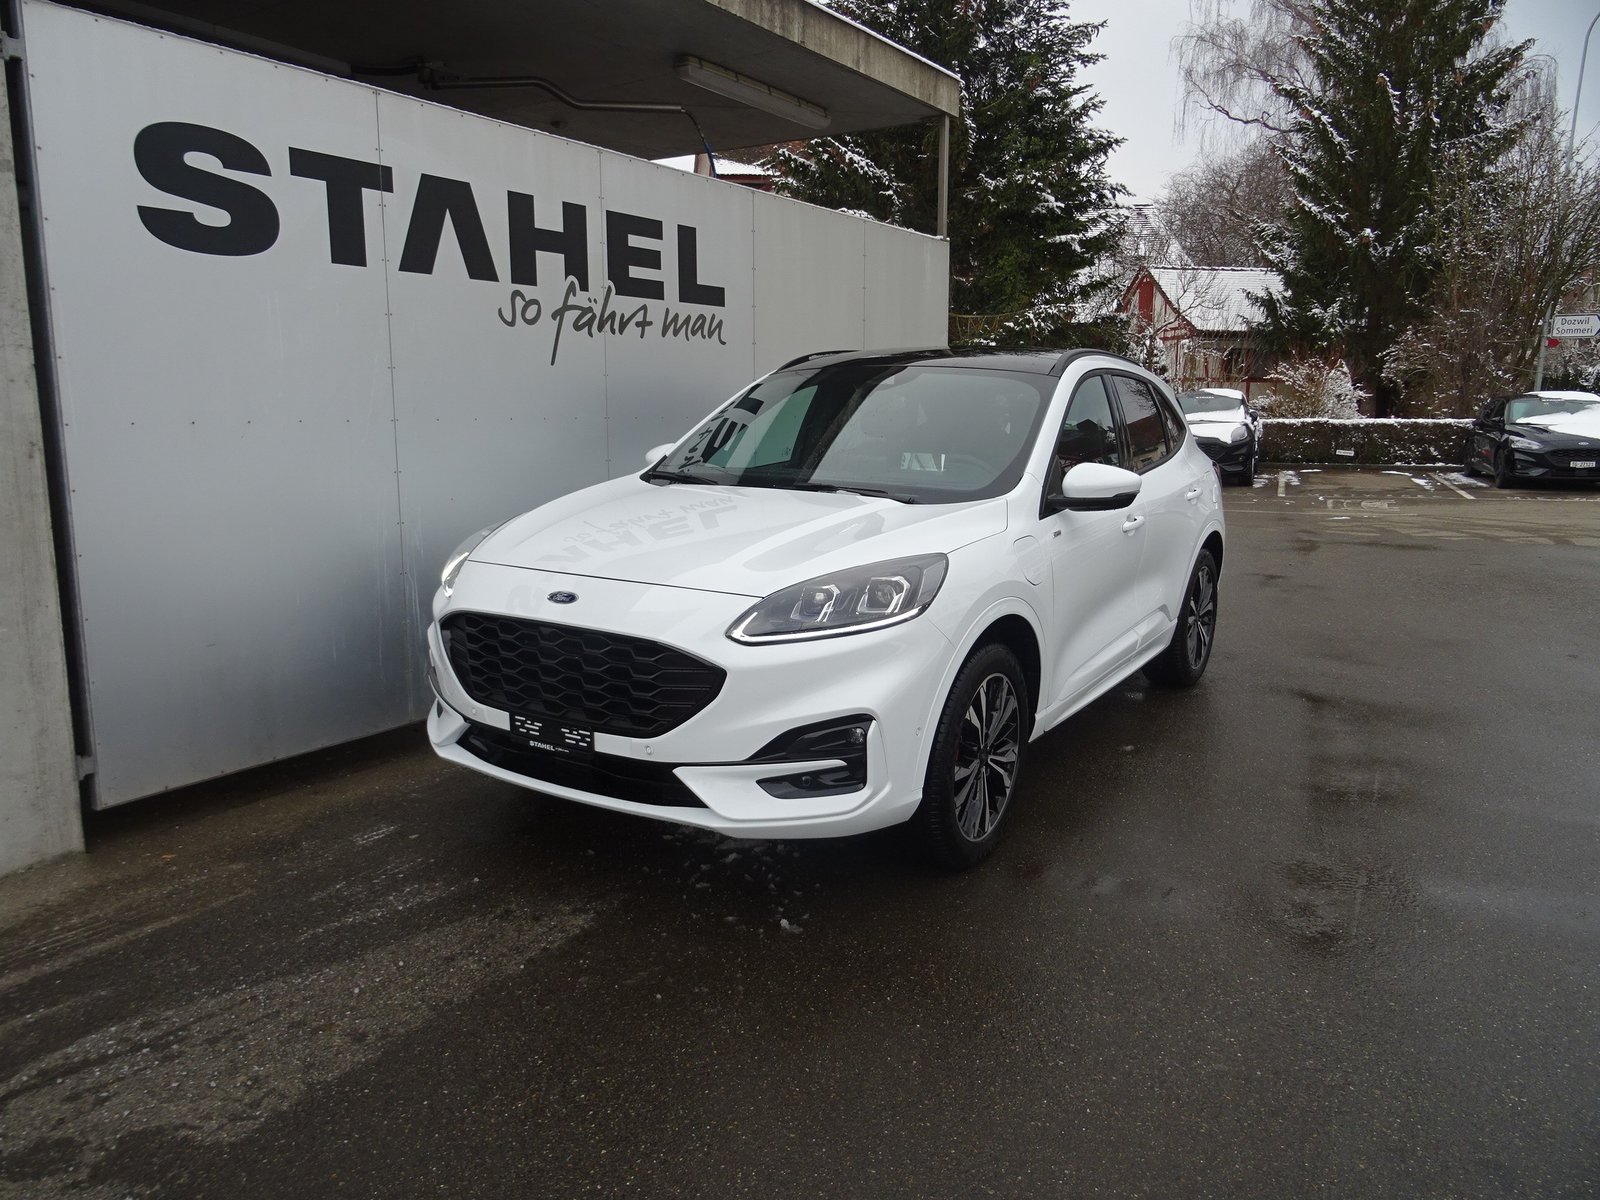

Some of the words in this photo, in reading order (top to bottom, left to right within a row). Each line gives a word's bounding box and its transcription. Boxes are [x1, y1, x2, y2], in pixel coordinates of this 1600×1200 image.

[133, 121, 726, 308] STAHEL
[551, 280, 653, 366] fährt
[661, 307, 727, 345] man
[1560, 316, 1590, 326] Dozwil
[1556, 326, 1593, 335] Sommeri
[529, 740, 556, 752] STAHEL
